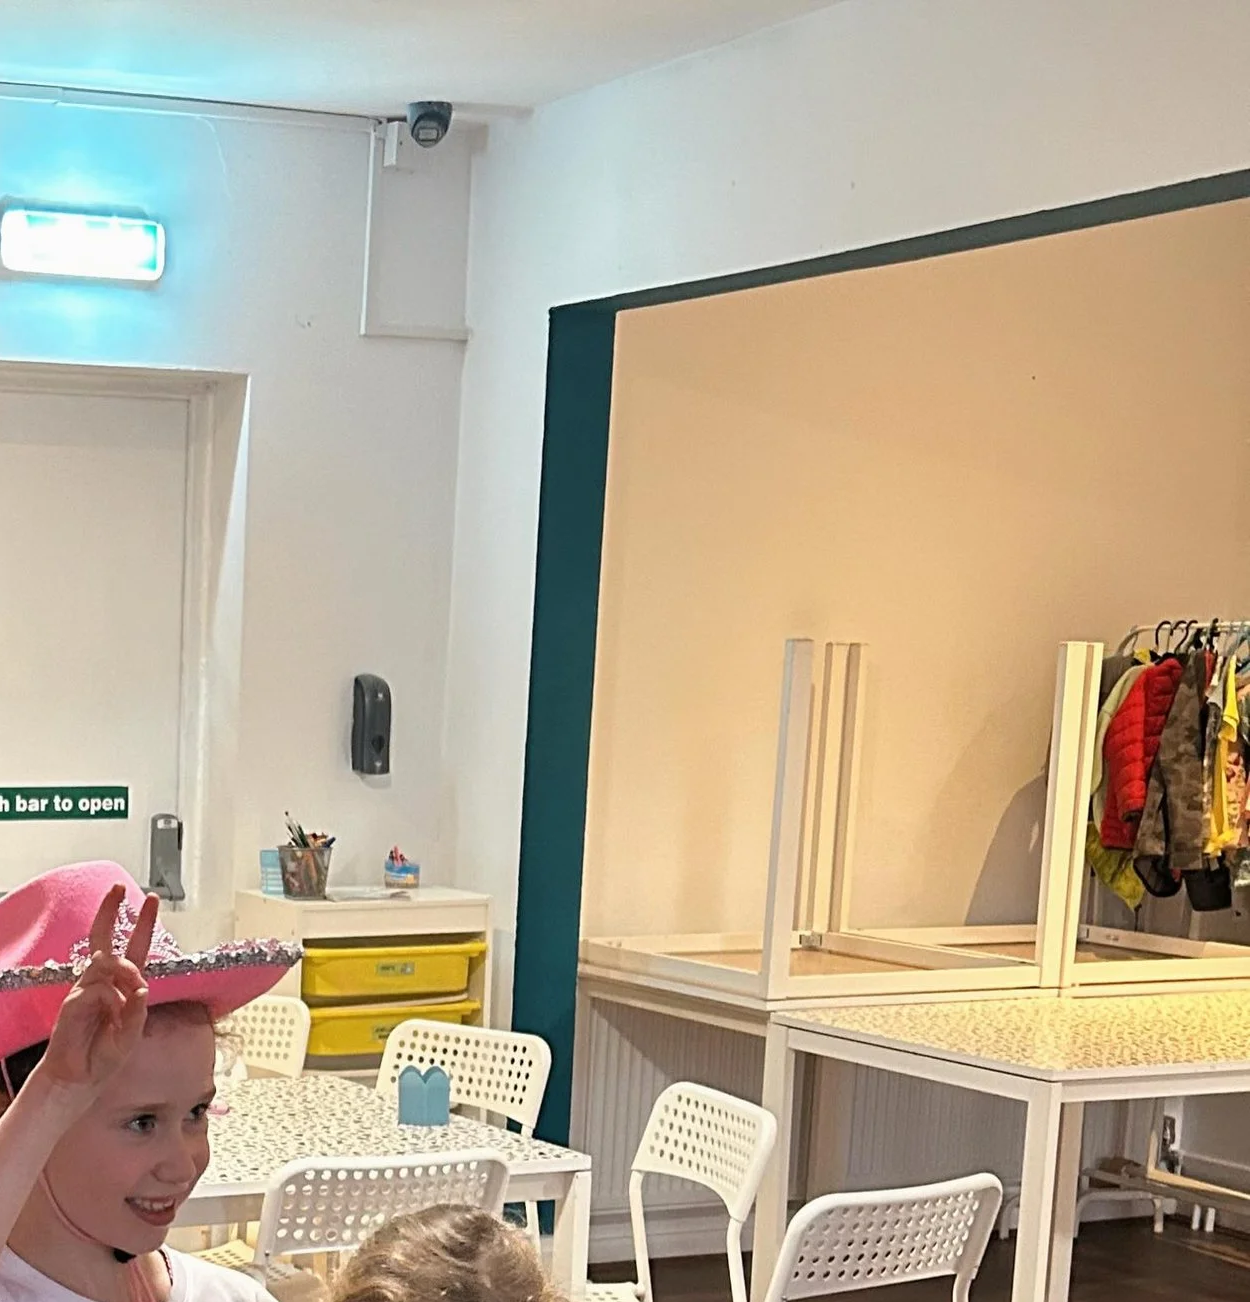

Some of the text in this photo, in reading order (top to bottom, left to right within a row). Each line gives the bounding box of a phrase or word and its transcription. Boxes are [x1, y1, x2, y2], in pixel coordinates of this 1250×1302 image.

[15, 795, 48, 812] bar
[54, 795, 73, 811] to
[78, 796, 125, 814] open
